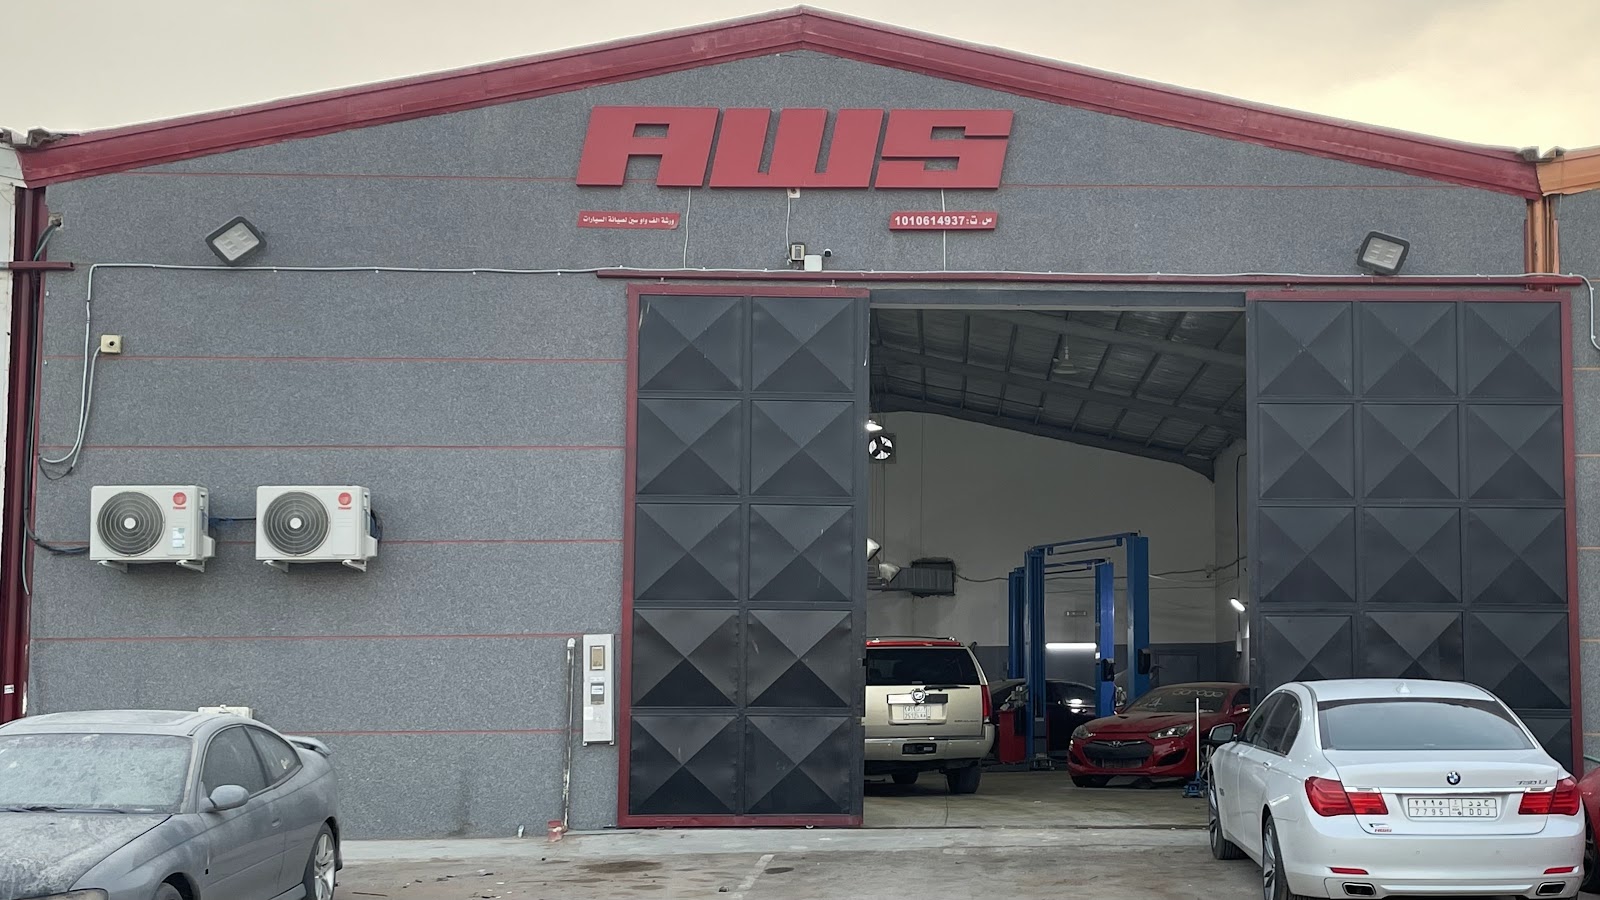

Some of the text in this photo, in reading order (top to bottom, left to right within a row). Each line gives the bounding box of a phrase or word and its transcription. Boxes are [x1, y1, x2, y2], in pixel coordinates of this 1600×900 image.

[576, 105, 1014, 190] AWS
[582, 215, 607, 224] السيارات
[608, 215, 628, 225] لصيانة
[660, 216, 675, 226] ورشة
[1415, 808, 1444, 816] 7795
